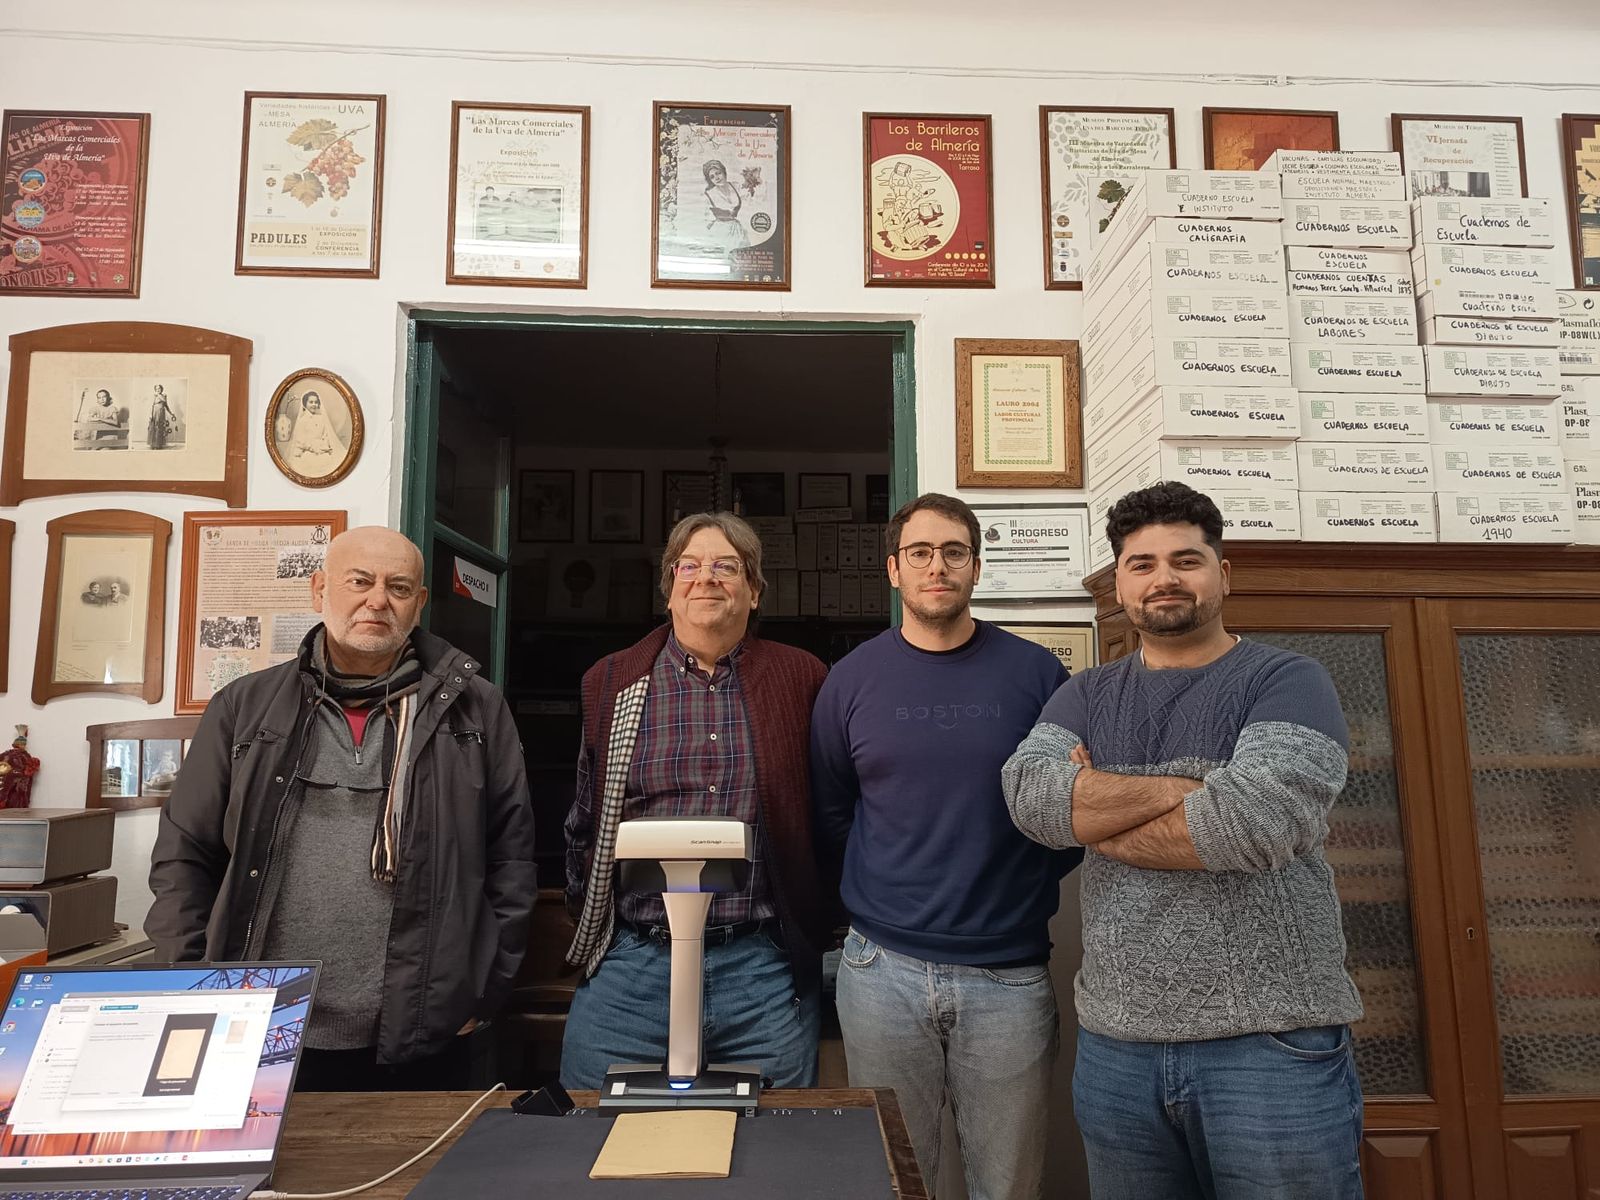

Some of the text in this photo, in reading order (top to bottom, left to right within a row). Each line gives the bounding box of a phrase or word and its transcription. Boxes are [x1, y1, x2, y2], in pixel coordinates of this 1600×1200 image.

[338, 104, 364, 114] UVA
[488, 118, 521, 126] Marcas
[522, 119, 574, 128] Comerciales
[472, 126, 483, 134] de
[495, 127, 512, 135] Uva
[889, 121, 980, 136] Los Barrileros
[48, 134, 121, 143] Marcas Comerciales
[1439, 136, 1468, 144] Jornada
[75, 143, 84, 152] la
[905, 138, 980, 152] de Almería
[61, 153, 72, 161] de
[1297, 177, 1330, 186] ESCUELA
[1181, 193, 1256, 203] CUADERNO ESCUELA
[1193, 205, 1233, 213] INSTITUTO
[1460, 214, 1531, 228] Cuadernos de
[1177, 223, 1232, 233] CUADERNOS
[1296, 221, 1399, 235] CUADERNOS ESCUELA
[250, 232, 308, 245] PADULES
[1318, 250, 1369, 261] CUADERNOS
[1325, 260, 1368, 269] ESCUELA
[1166, 267, 1267, 282] CUADERNOS ESCUELA
[1295, 272, 1341, 281] CUADERNOS
[1449, 265, 1539, 278] CUADERNOS ESCUELA
[1178, 314, 1267, 323] CUADERNOS ESCUELA
[1304, 316, 1357, 326] CUADERNOS
[1372, 318, 1409, 326] ESCUELA
[1450, 320, 1549, 333] CUADERNOS DE ESCUELA
[1318, 328, 1366, 338] LABORES
[1182, 361, 1277, 374] CUADERNOS ESCUELA
[1317, 367, 1402, 377] CUADERNOS ESCUELA
[1454, 367, 1497, 376] CUADERNOS
[1510, 369, 1542, 378] ESCUELA
[1479, 379, 1511, 388] DIBUJO
[1190, 409, 1285, 421] CUADERNOS ESCUELA
[1323, 421, 1409, 431] CUADERNOS ESCUELA
[1450, 422, 1545, 433] CUADERNOS DE ESCUELA
[1187, 467, 1272, 479] CUADERNOS ESCUELA
[1328, 466, 1429, 475] CUADERNOS DE ESCUELA
[1462, 469, 1561, 479] CUADERNOS DE ESCUELA
[1009, 520, 1018, 528] III
[1240, 519, 1274, 528] ESCUELA
[1327, 519, 1419, 527] CUADERNOS ESCUELA
[1470, 514, 1559, 525] CUADERNOS ESCUELA
[1010, 528, 1070, 538] PROGRESO
[1482, 527, 1513, 540] 1940
[462, 572, 486, 592] DESPACHO
[895, 704, 1000, 720] BOSTON
